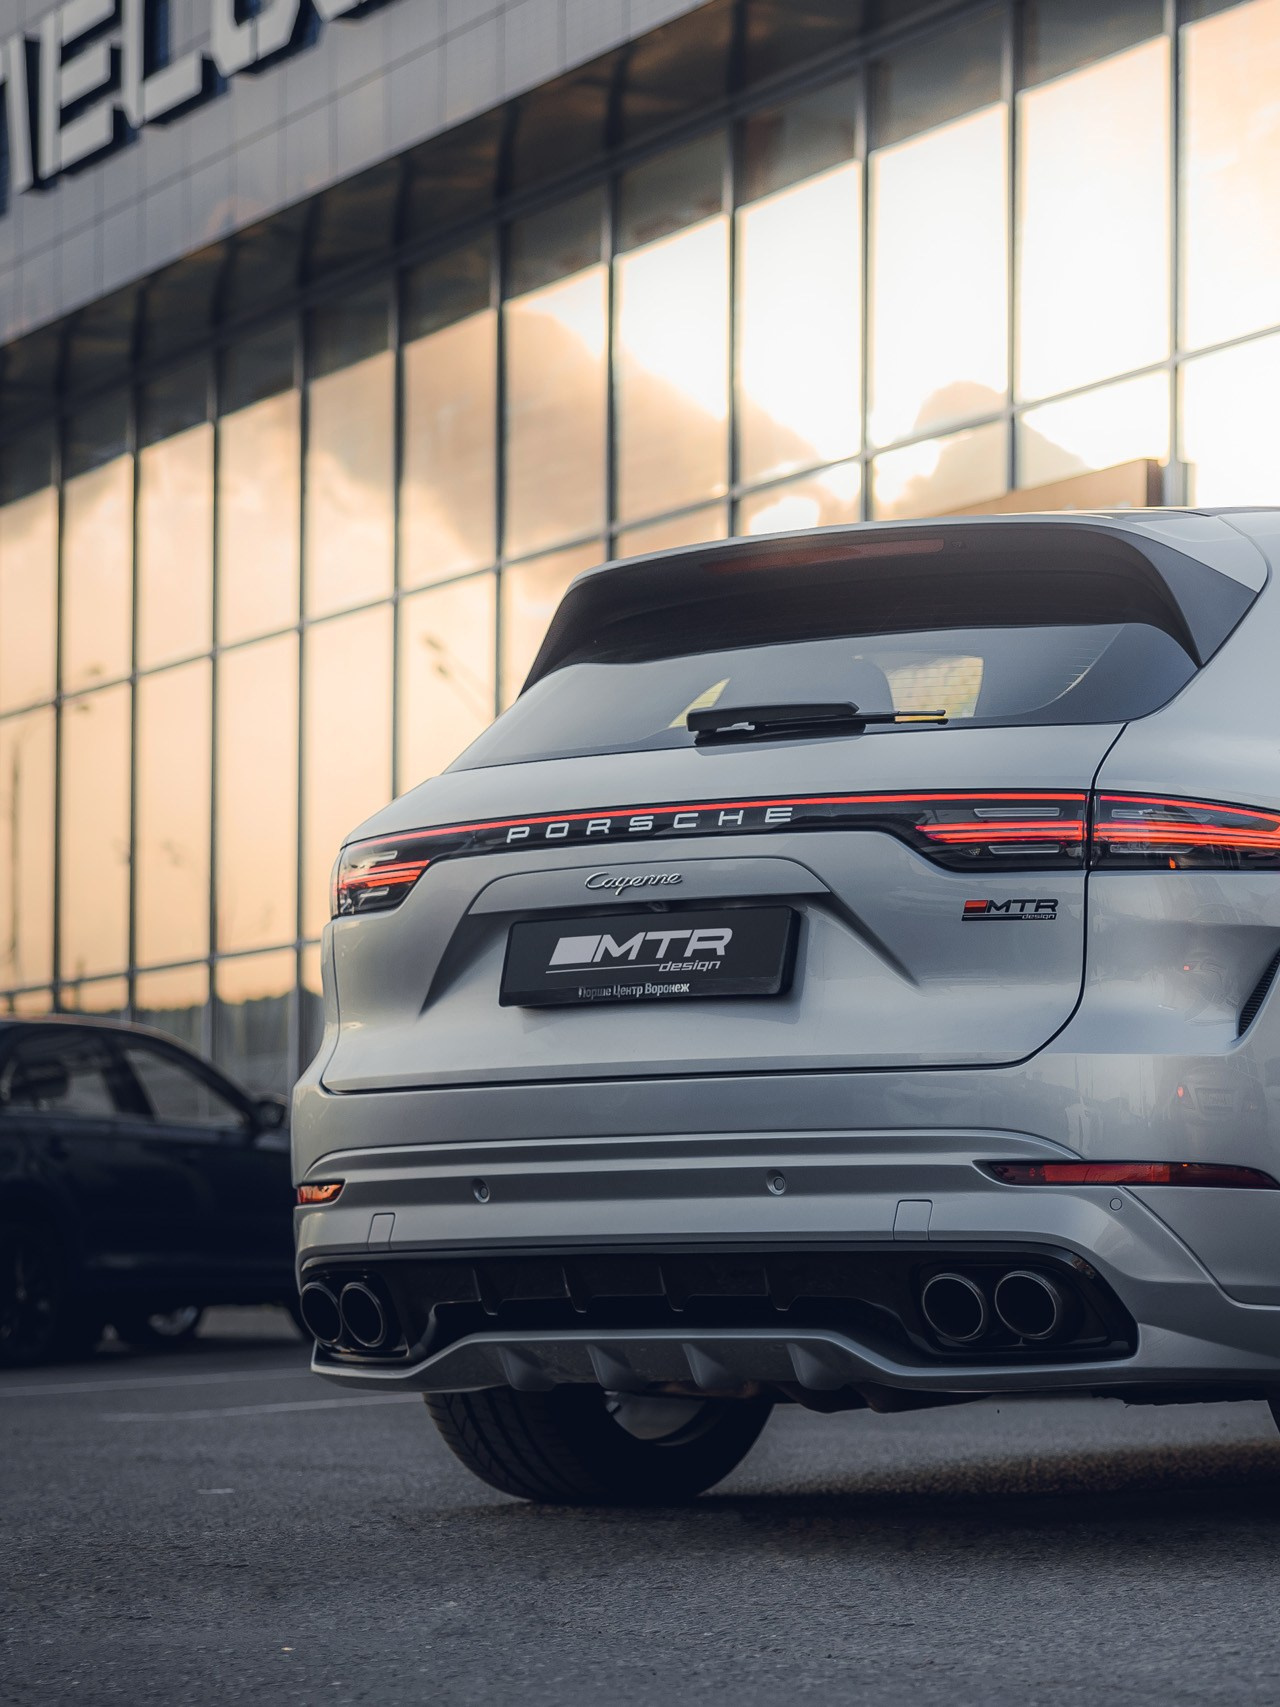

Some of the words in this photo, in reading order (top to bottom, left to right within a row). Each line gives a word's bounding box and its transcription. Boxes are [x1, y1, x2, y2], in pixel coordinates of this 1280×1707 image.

[506, 806, 794, 844] PORSCHE
[584, 871, 684, 896] Cayenne
[987, 899, 1059, 913] MTR
[592, 927, 733, 963] MTR
[658, 960, 721, 973] design
[578, 986, 612, 999] Порше
[613, 984, 643, 998] Центр
[645, 982, 691, 997] Воронеж
